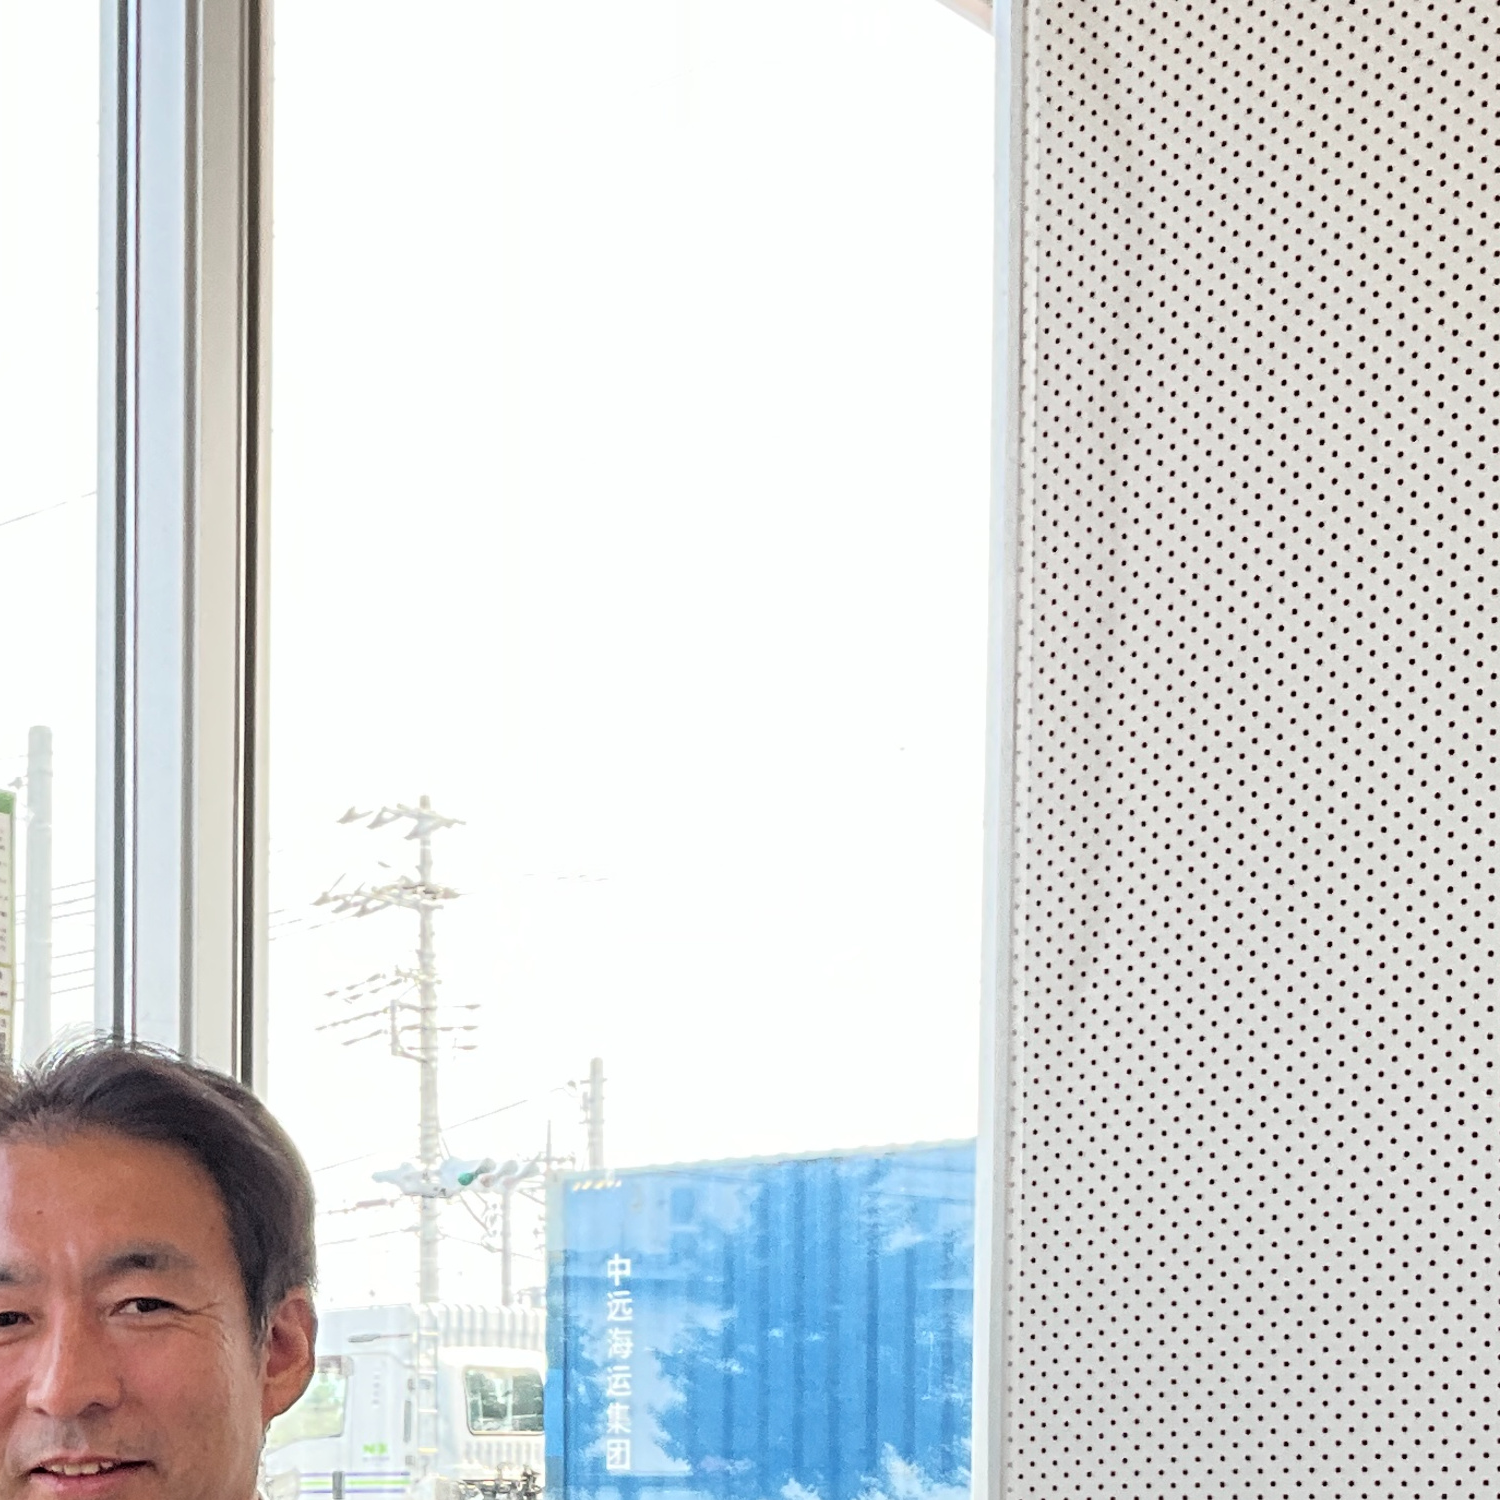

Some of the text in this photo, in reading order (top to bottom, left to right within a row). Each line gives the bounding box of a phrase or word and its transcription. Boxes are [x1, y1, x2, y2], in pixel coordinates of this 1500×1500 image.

[605, 1253, 634, 1471] 中远海运集团
